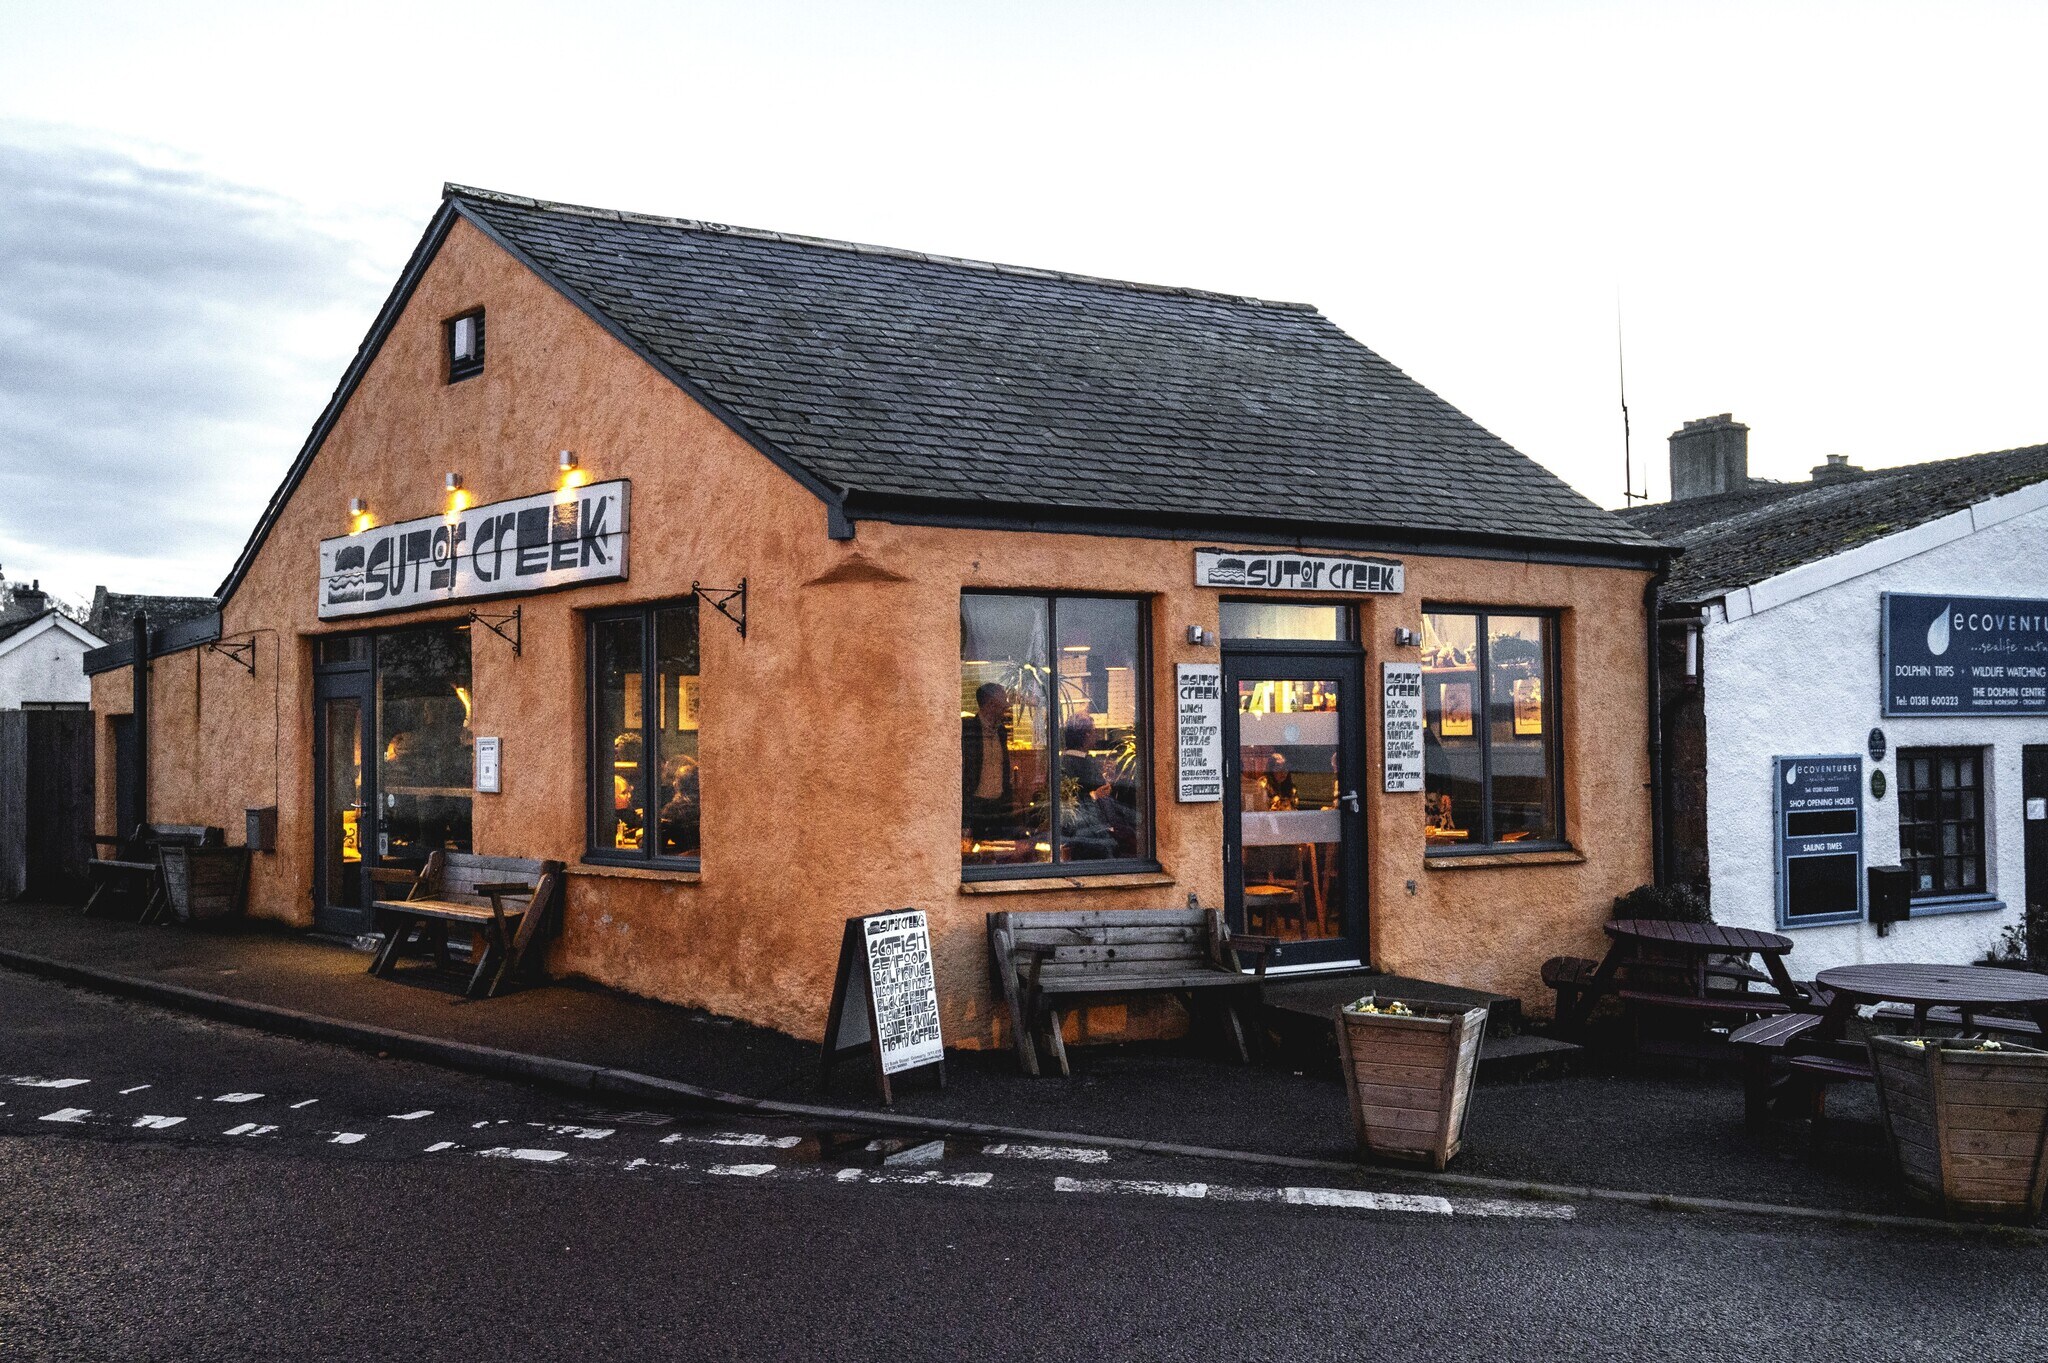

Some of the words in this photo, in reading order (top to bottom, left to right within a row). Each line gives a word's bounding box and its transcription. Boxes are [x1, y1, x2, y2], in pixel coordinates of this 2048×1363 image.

[1895, 665, 1931, 677] DOLPHIN
[1935, 666, 1954, 677] TRIPS
[1972, 666, 2004, 677] WILDLIFE
[2006, 666, 2046, 678] WATCHING
[1972, 687, 1985, 697] THE
[1987, 687, 2019, 697] DOLPHIN
[2021, 687, 2046, 697] CENTRE
[1910, 696, 1929, 706] 01381
[1931, 696, 1959, 706] 600323
[1180, 703, 1203, 714] LUNCH
[1181, 735, 1211, 746] PIZZAS
[1181, 758, 1207, 767] BAKING
[1789, 800, 1806, 808] SHOP
[1807, 798, 1833, 806] OPENING
[1834, 797, 1855, 806] HOURS
[1803, 844, 1825, 852] SAILING
[1826, 842, 1843, 851] TIMES
[872, 950, 928, 972] SEAFOOD
[880, 1019, 907, 1038] HOME
[906, 1011, 938, 1031] BAKING
